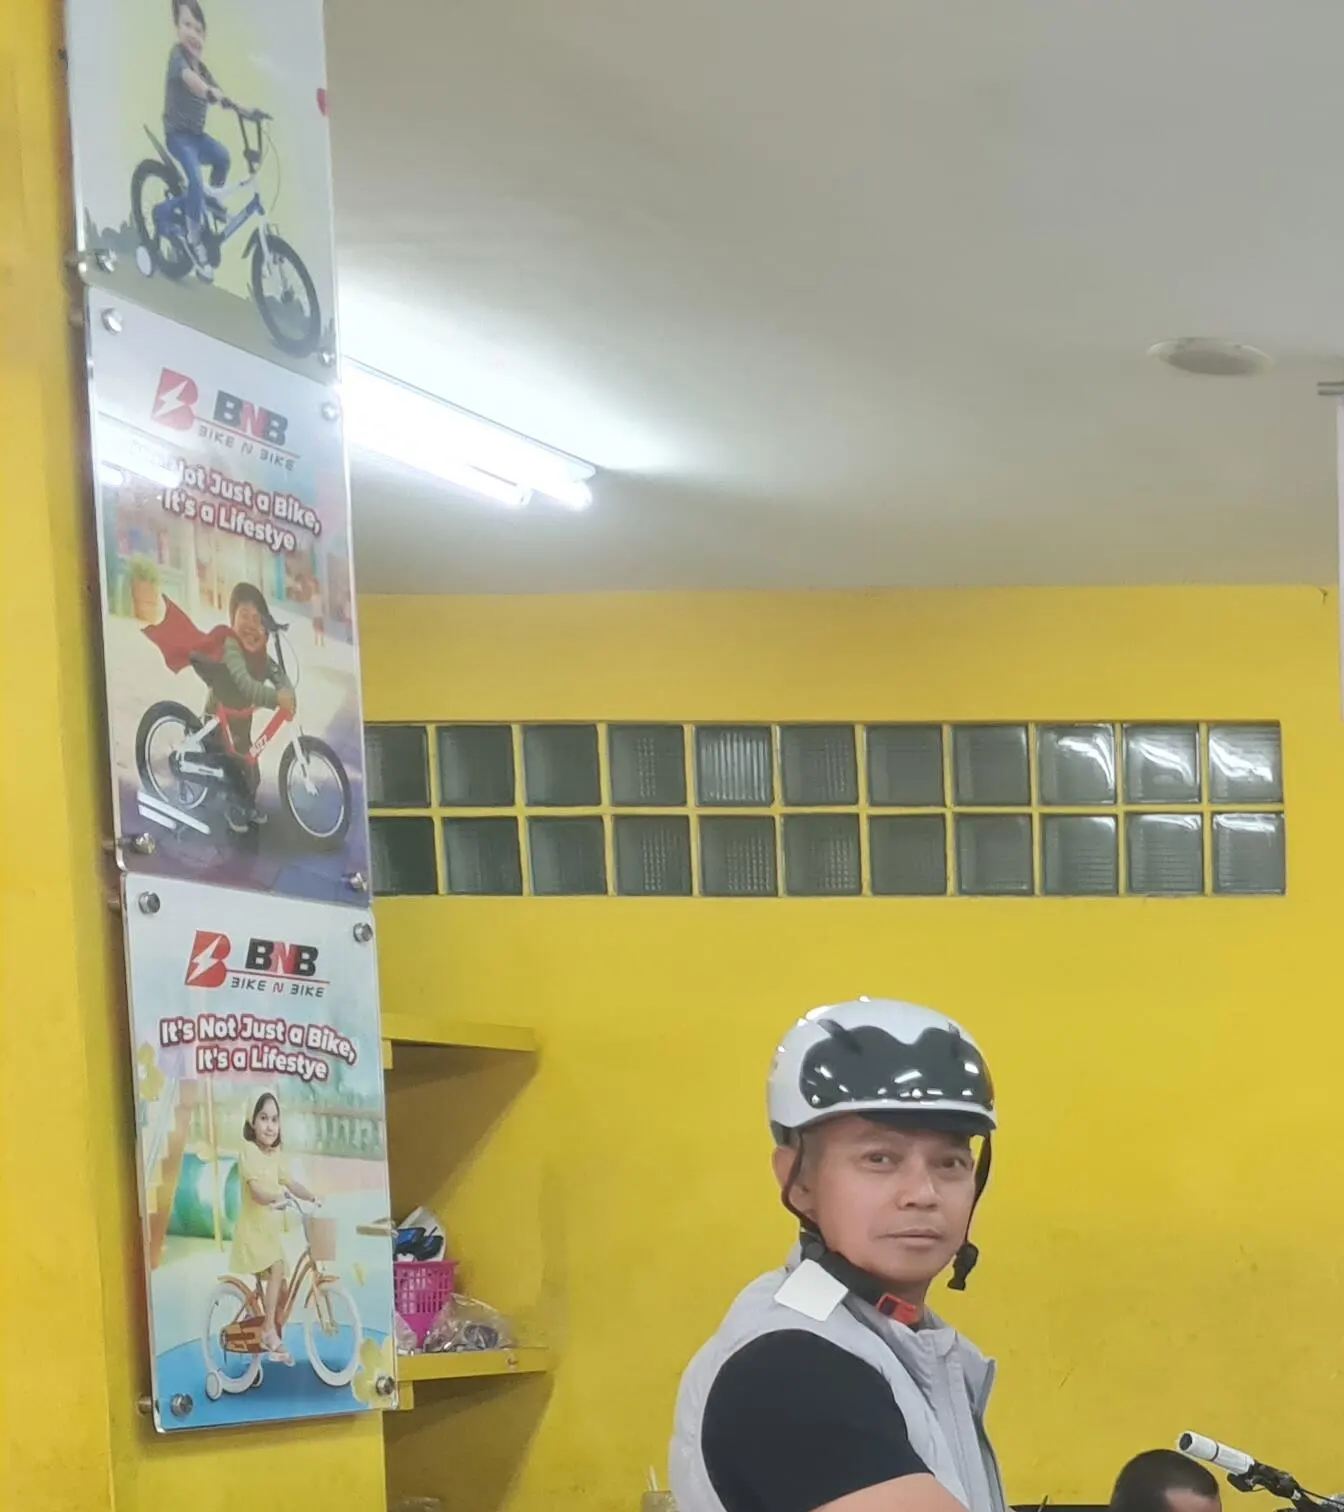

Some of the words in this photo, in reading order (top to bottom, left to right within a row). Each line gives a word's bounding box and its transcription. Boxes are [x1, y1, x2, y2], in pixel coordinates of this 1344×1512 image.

[213, 390, 288, 446] BNB
[209, 469, 252, 504] Just
[256, 494, 271, 511] a
[200, 504, 215, 523] a
[245, 938, 319, 976] BNB
[231, 977, 267, 991] BIKE
[290, 983, 325, 998] BIKE
[160, 1017, 195, 1046] It's
[198, 1013, 238, 1040] Not
[240, 1015, 285, 1043] Just
[288, 1025, 304, 1044] a
[306, 1023, 357, 1065] Bike,
[197, 1046, 229, 1073] It's
[232, 1047, 248, 1067] a
[250, 1045, 329, 1082] Lifestye
